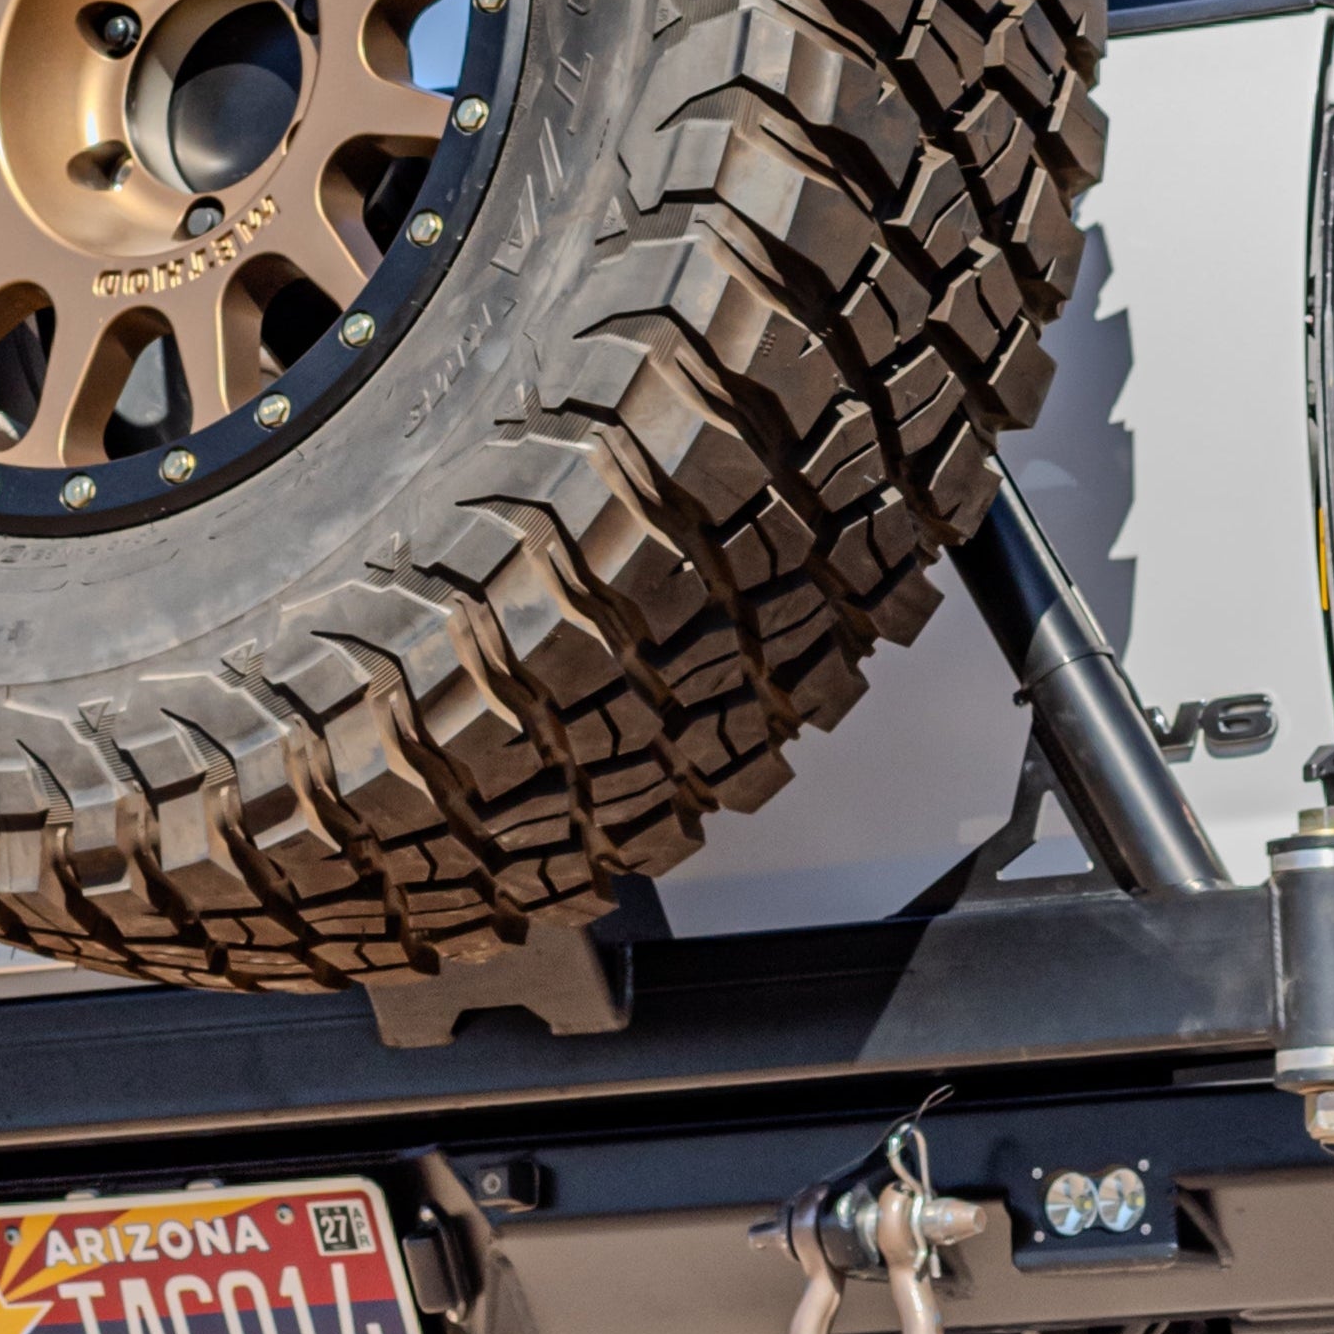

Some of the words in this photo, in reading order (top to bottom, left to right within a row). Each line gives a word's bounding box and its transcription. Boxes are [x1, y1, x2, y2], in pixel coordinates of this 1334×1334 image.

[92, 194, 290, 299] METHOD
[44, 1214, 271, 1268] ARIZONA
[320, 1214, 348, 1244] 27
[352, 1207, 371, 1247] APR
